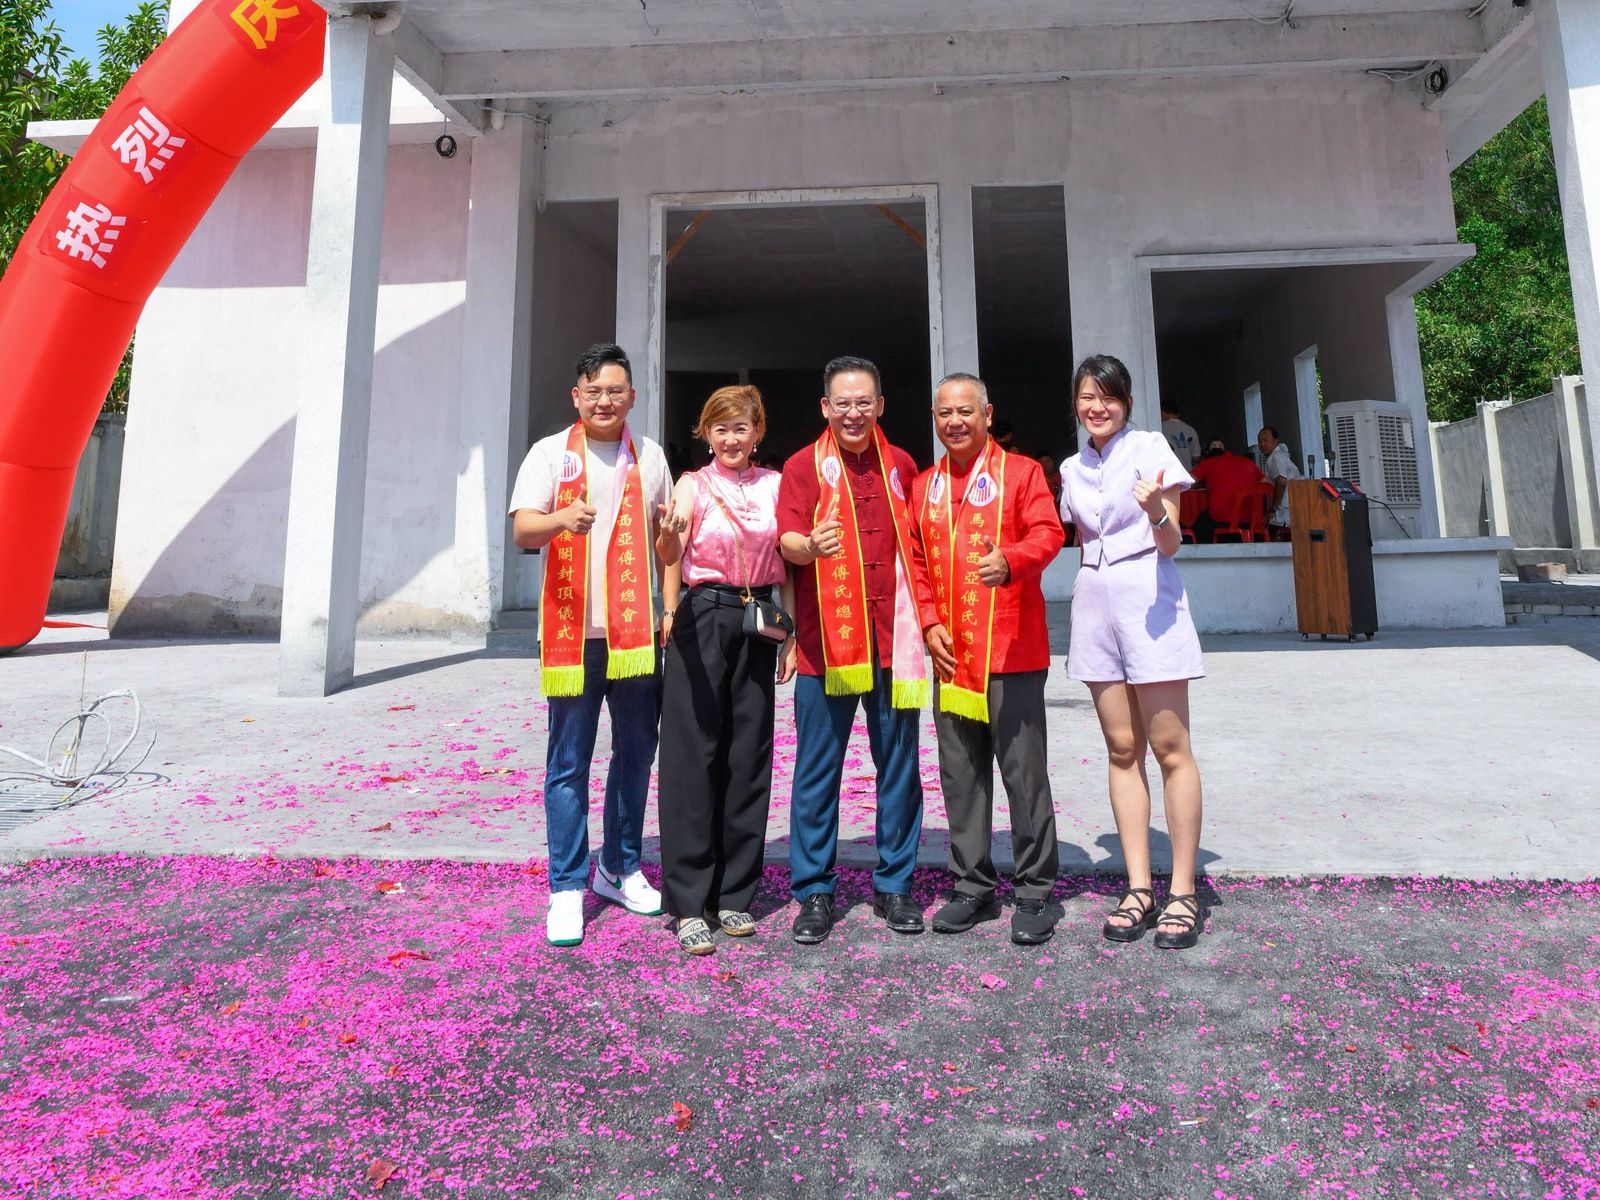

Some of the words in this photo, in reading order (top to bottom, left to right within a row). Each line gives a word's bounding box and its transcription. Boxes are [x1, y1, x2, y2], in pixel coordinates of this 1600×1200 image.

[556, 488, 577, 641] 傅樓閣封頂儀式
